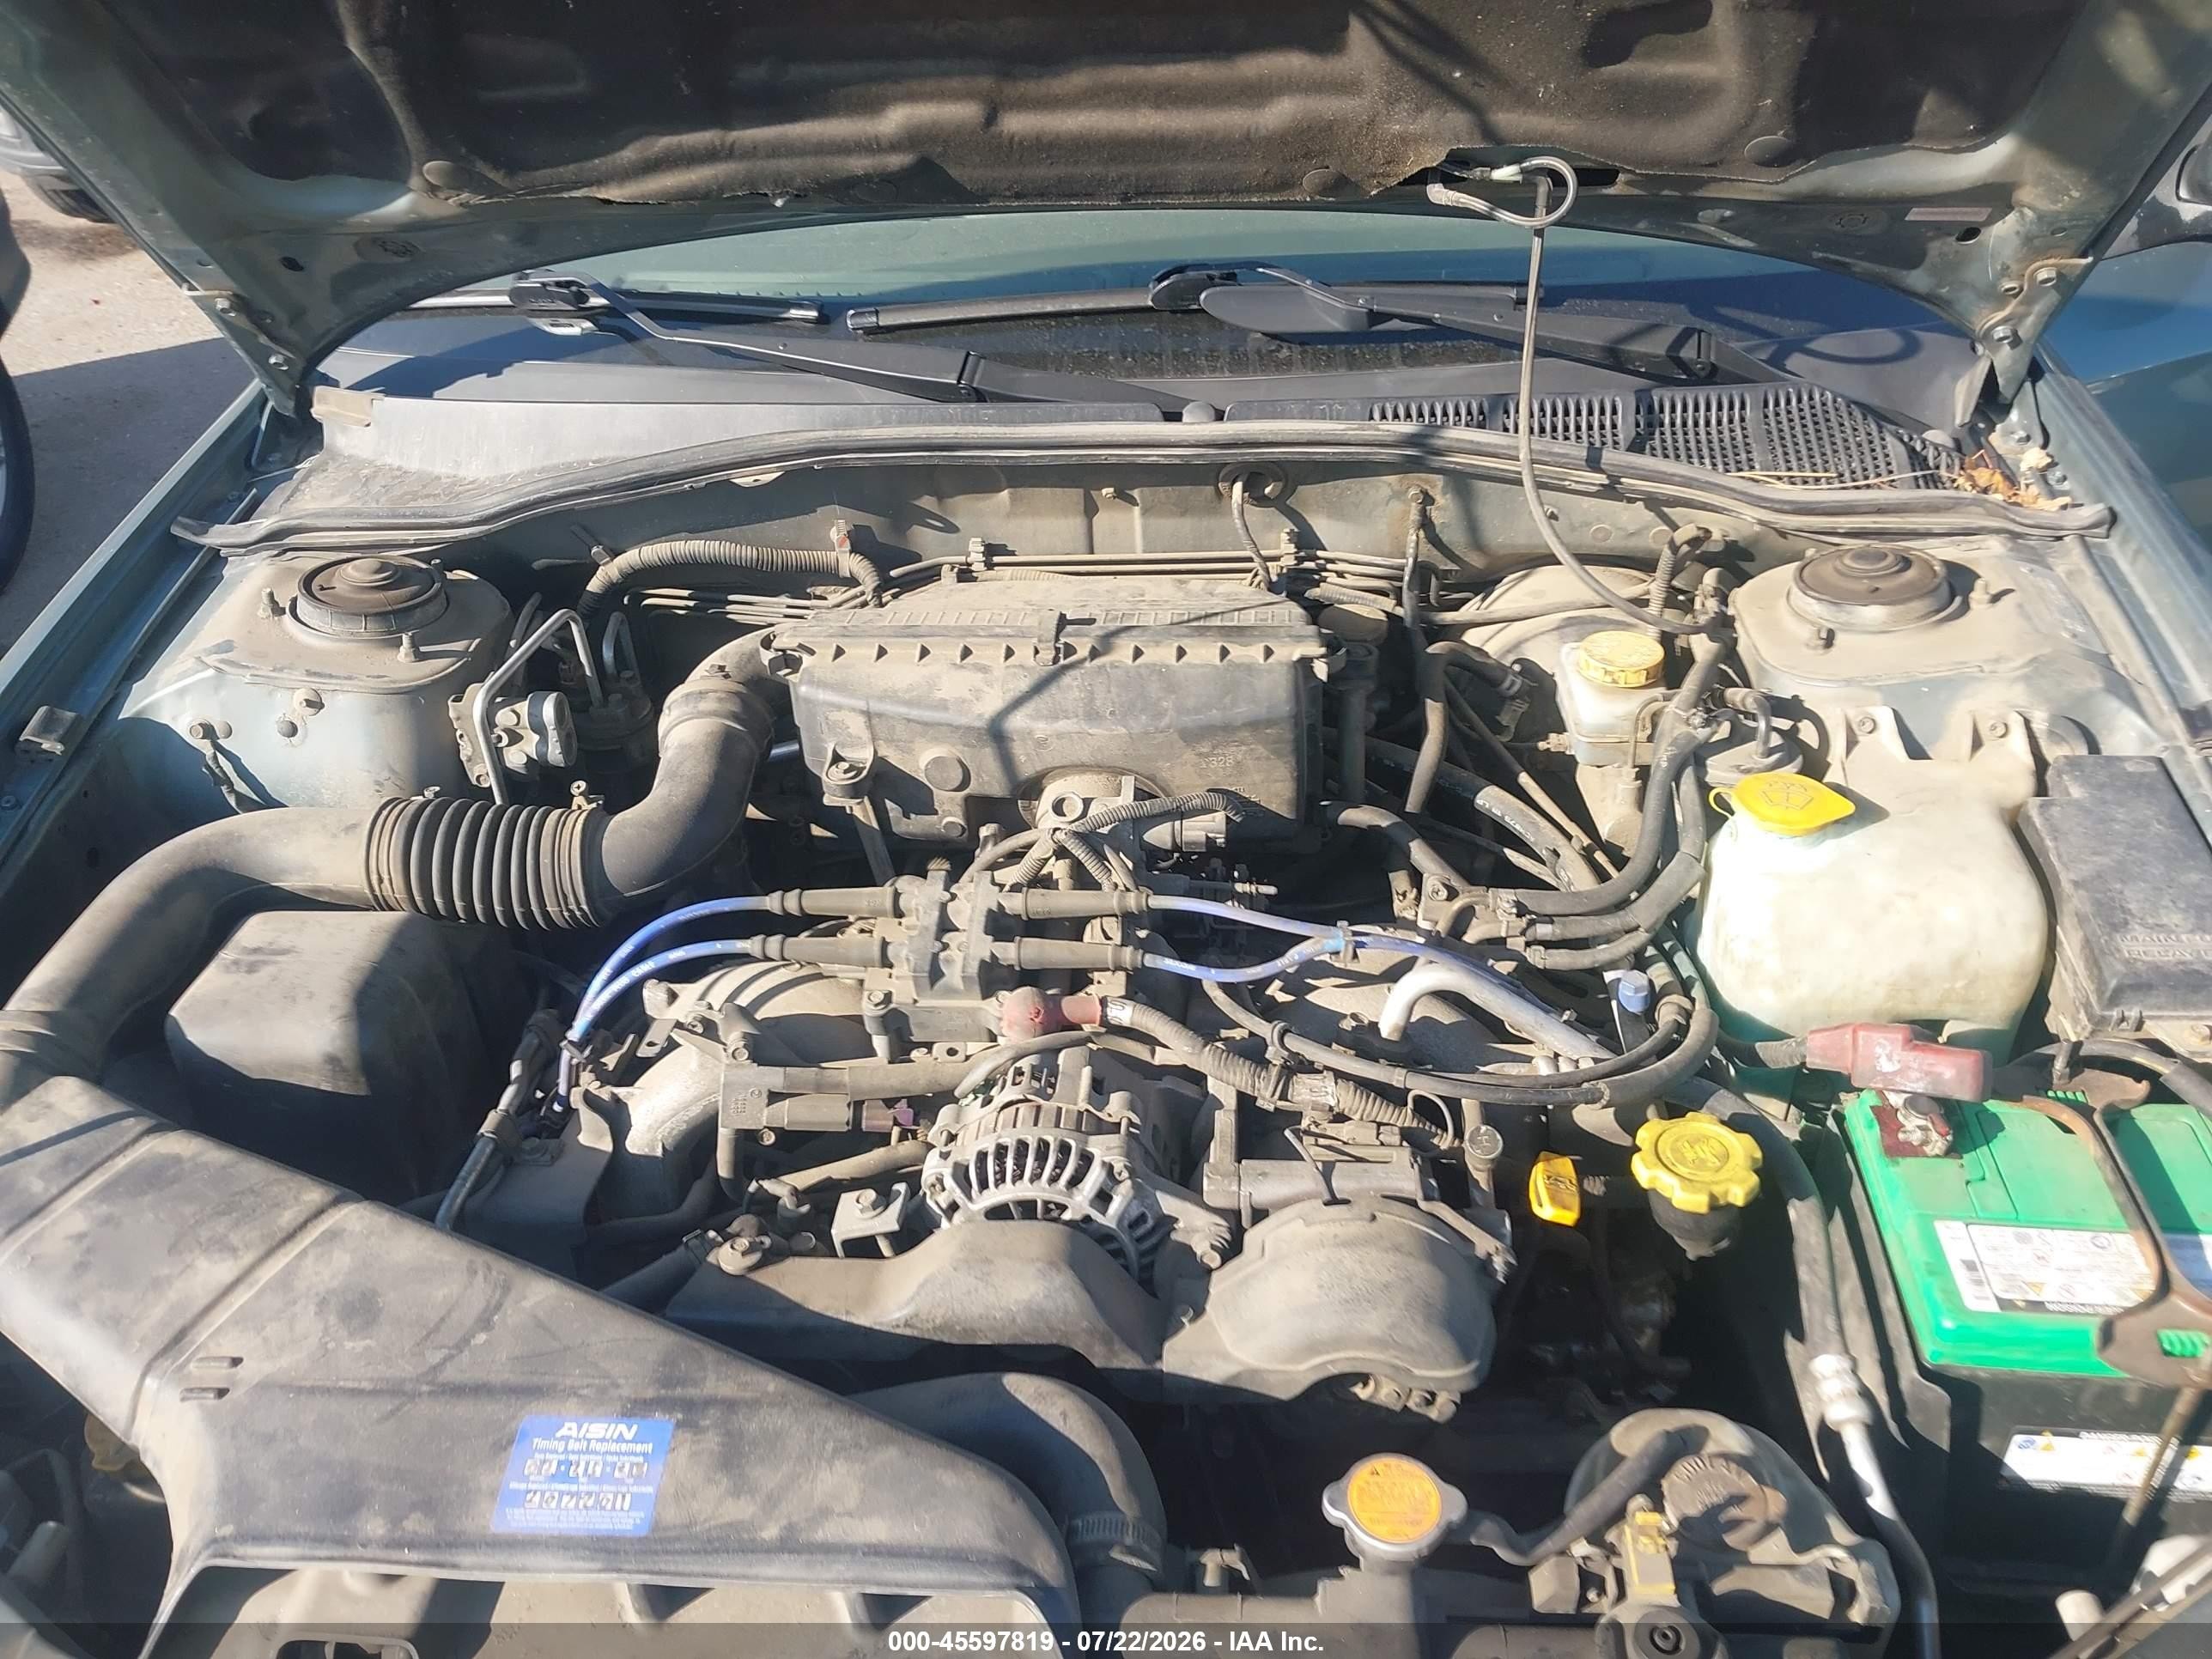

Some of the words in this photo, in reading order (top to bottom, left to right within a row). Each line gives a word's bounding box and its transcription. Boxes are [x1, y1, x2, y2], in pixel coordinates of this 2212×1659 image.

[556, 1422, 638, 1440] AISIN
[532, 1437, 565, 1452] Timing
[568, 1439, 587, 1452] Belt
[589, 1440, 653, 1455] Replacement
